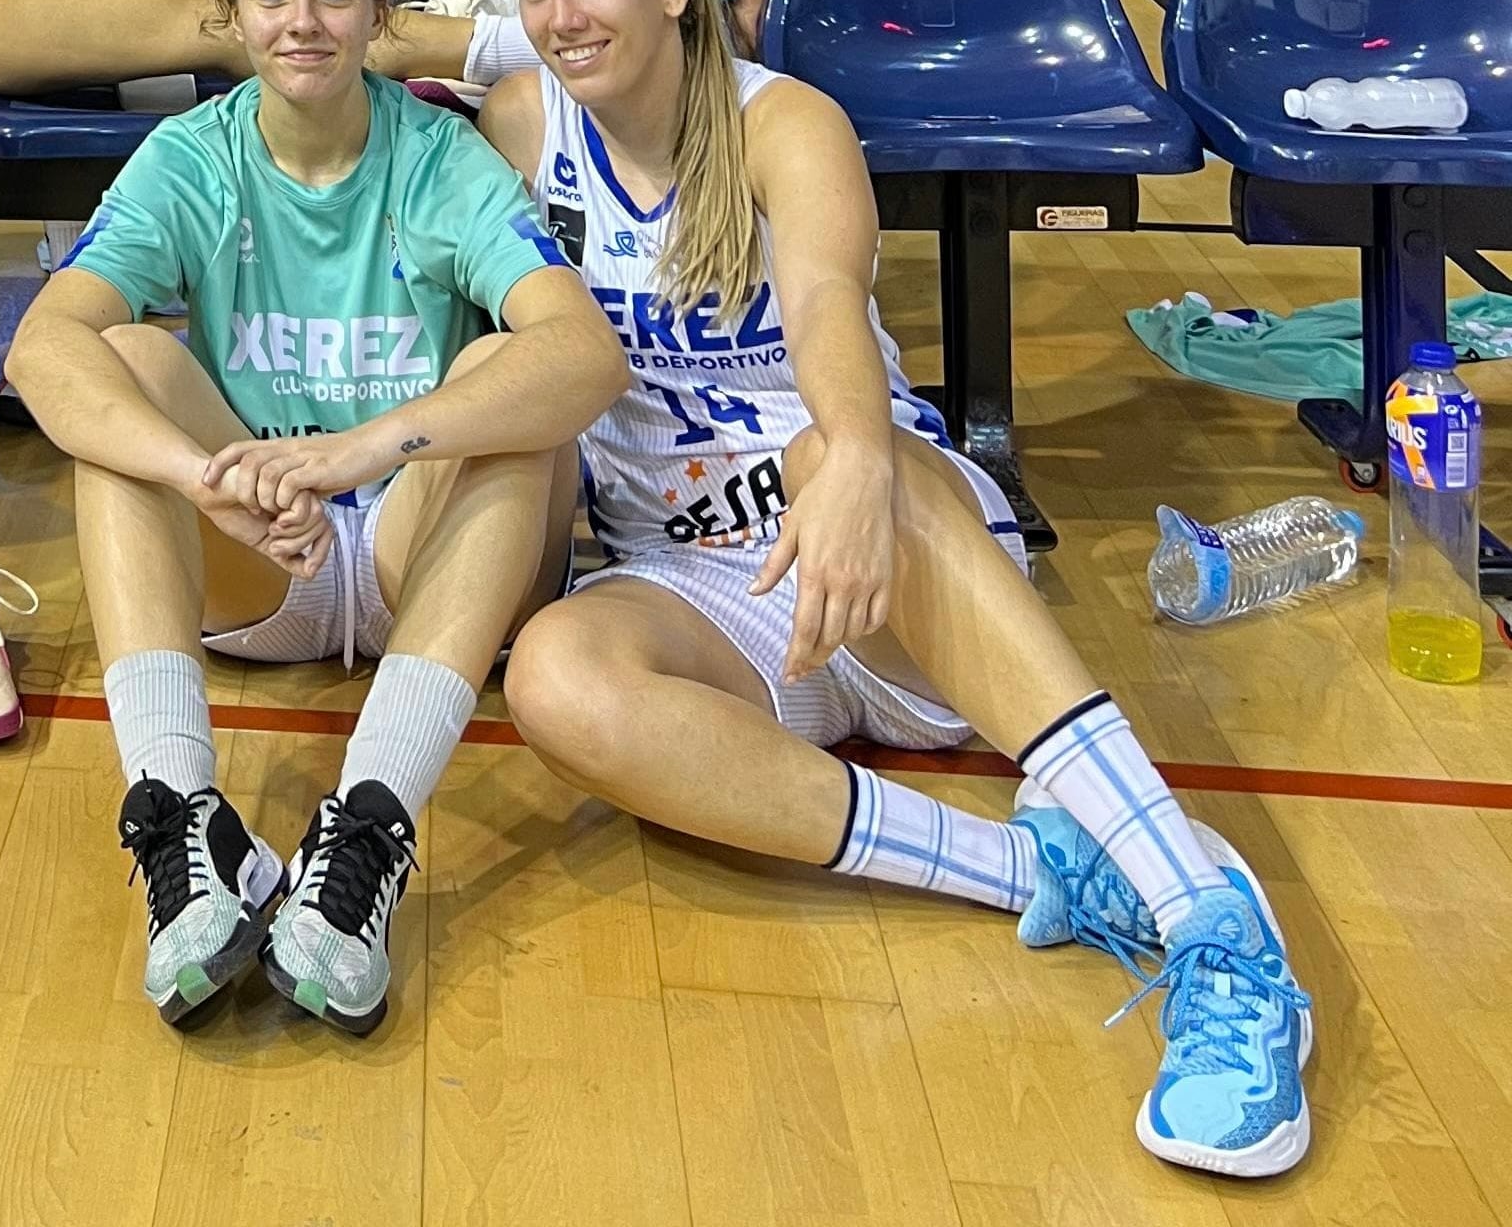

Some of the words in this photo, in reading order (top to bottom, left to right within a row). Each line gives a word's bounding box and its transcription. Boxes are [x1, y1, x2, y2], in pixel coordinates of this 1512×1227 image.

[227, 312, 431, 379] XEREZ
[590, 282, 784, 353] EREZ
[315, 378, 436, 403] DEPORTIVO
[651, 346, 787, 370] DEPORTIVO
[642, 380, 764, 447] 14
